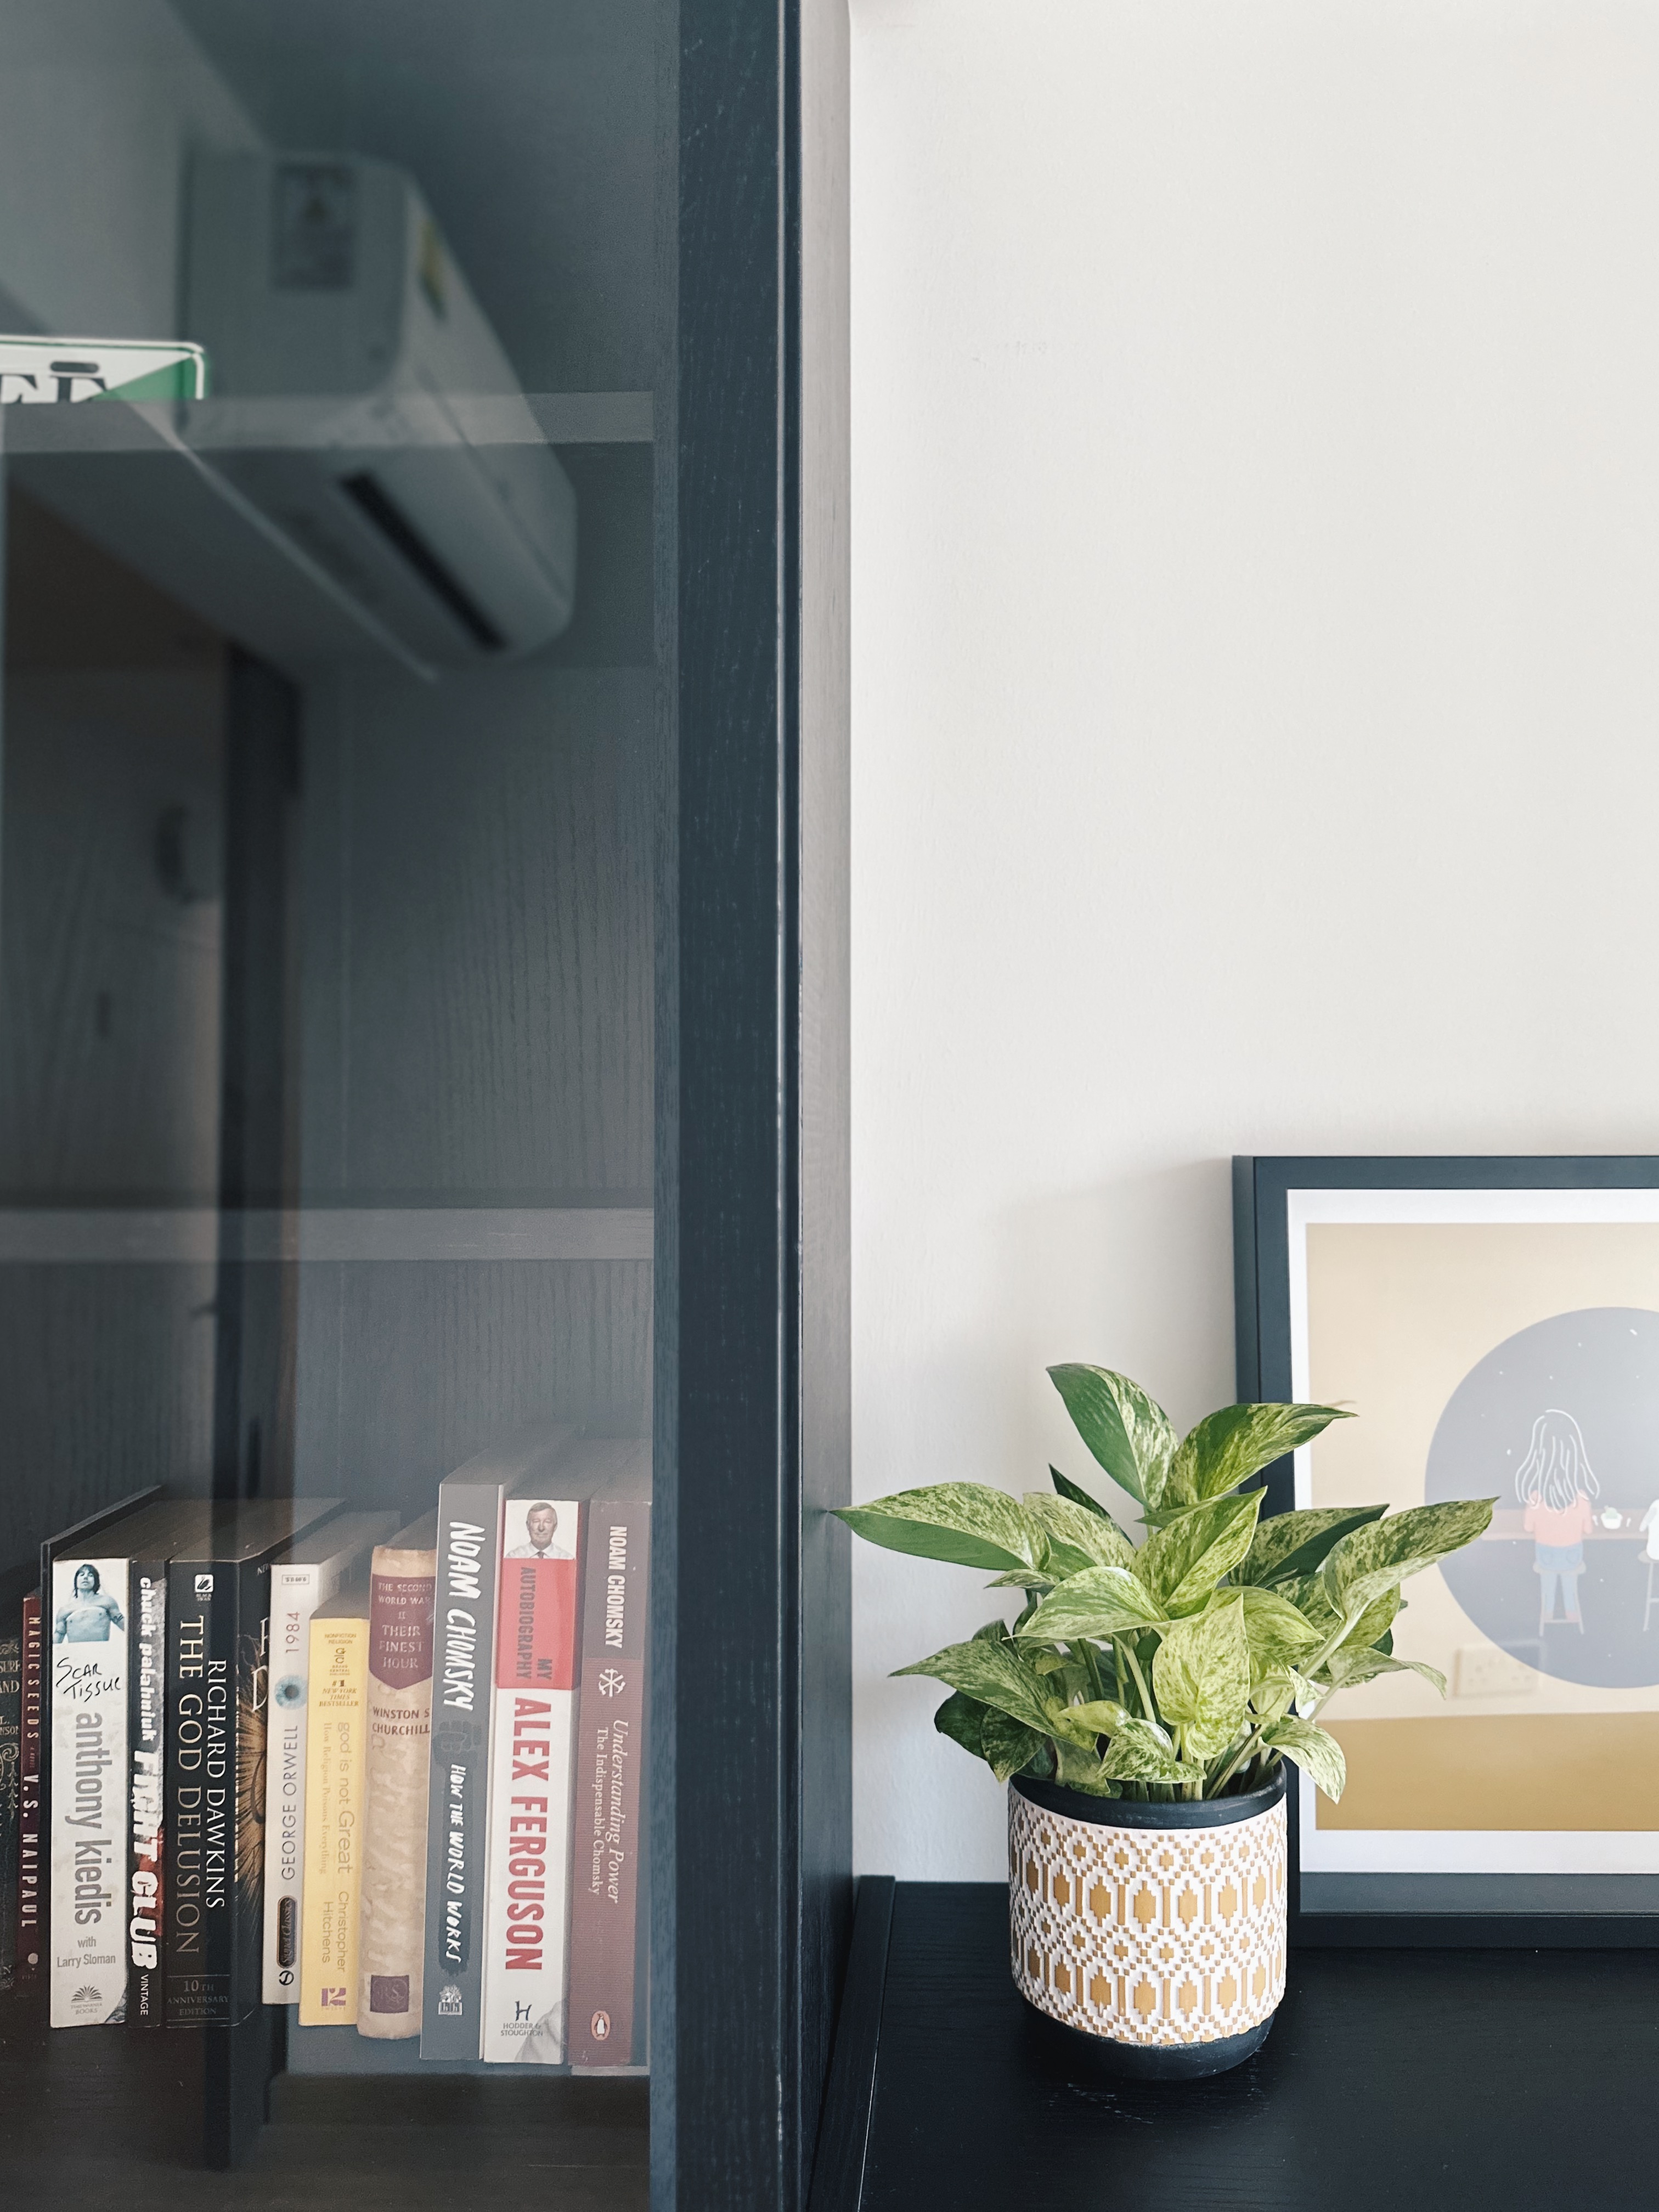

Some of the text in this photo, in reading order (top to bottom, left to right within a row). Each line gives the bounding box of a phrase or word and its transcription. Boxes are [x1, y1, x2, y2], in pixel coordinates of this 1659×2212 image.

[285, 1611, 300, 1654] 1984
[378, 1582, 432, 1592] THE SECOND
[378, 1595, 431, 1605] WORLD WAR
[382, 1624, 421, 1637] THEIR
[443, 1521, 486, 1712] NOAM CHOMSKY
[515, 1566, 537, 1680] AUTOBIOGRAPHY
[605, 1525, 628, 1649] NOAM CHOMSKY
[27, 1617, 41, 1739] MAGIC SEEDS
[139, 1576, 157, 1742] chuck palahniuk
[379, 1641, 425, 1653] FINEST
[383, 1656, 419, 1669] HOUR
[537, 1658, 553, 1680] MY
[371, 1722, 431, 1736] CHURCHILL
[373, 1706, 420, 1719] WINSTON
[65, 1712, 112, 1925] anthony kiedis
[176, 1615, 205, 1953] THE GOD DELUSION
[205, 1660, 227, 1909] RICHARD DAWKINS
[282, 1725, 298, 1881] GEORGE ORWELL
[319, 1722, 332, 1875] How Religion Poisons Everything
[337, 1722, 356, 1874] god is not Great
[588, 1726, 610, 1895] The Indispensable Chomsky
[605, 1719, 629, 1905] Understanding Power
[22, 1833, 38, 1927] NAIPAUL
[129, 1750, 159, 1970] FIGHT CLUB
[445, 1764, 467, 1963] HOW THE WORLD WORKS
[505, 1697, 552, 1971] ALEX FERGUSON
[57, 1954, 116, 1968] Larry Sloman
[77, 1936, 97, 1948] with
[321, 1901, 334, 1963] Hitchens
[335, 1891, 349, 1973] Christopher
[140, 1974, 149, 2016] VINTAGE
[167, 1995, 228, 2004] ANNIVERSARY
[179, 2007, 217, 2016] EDITION
